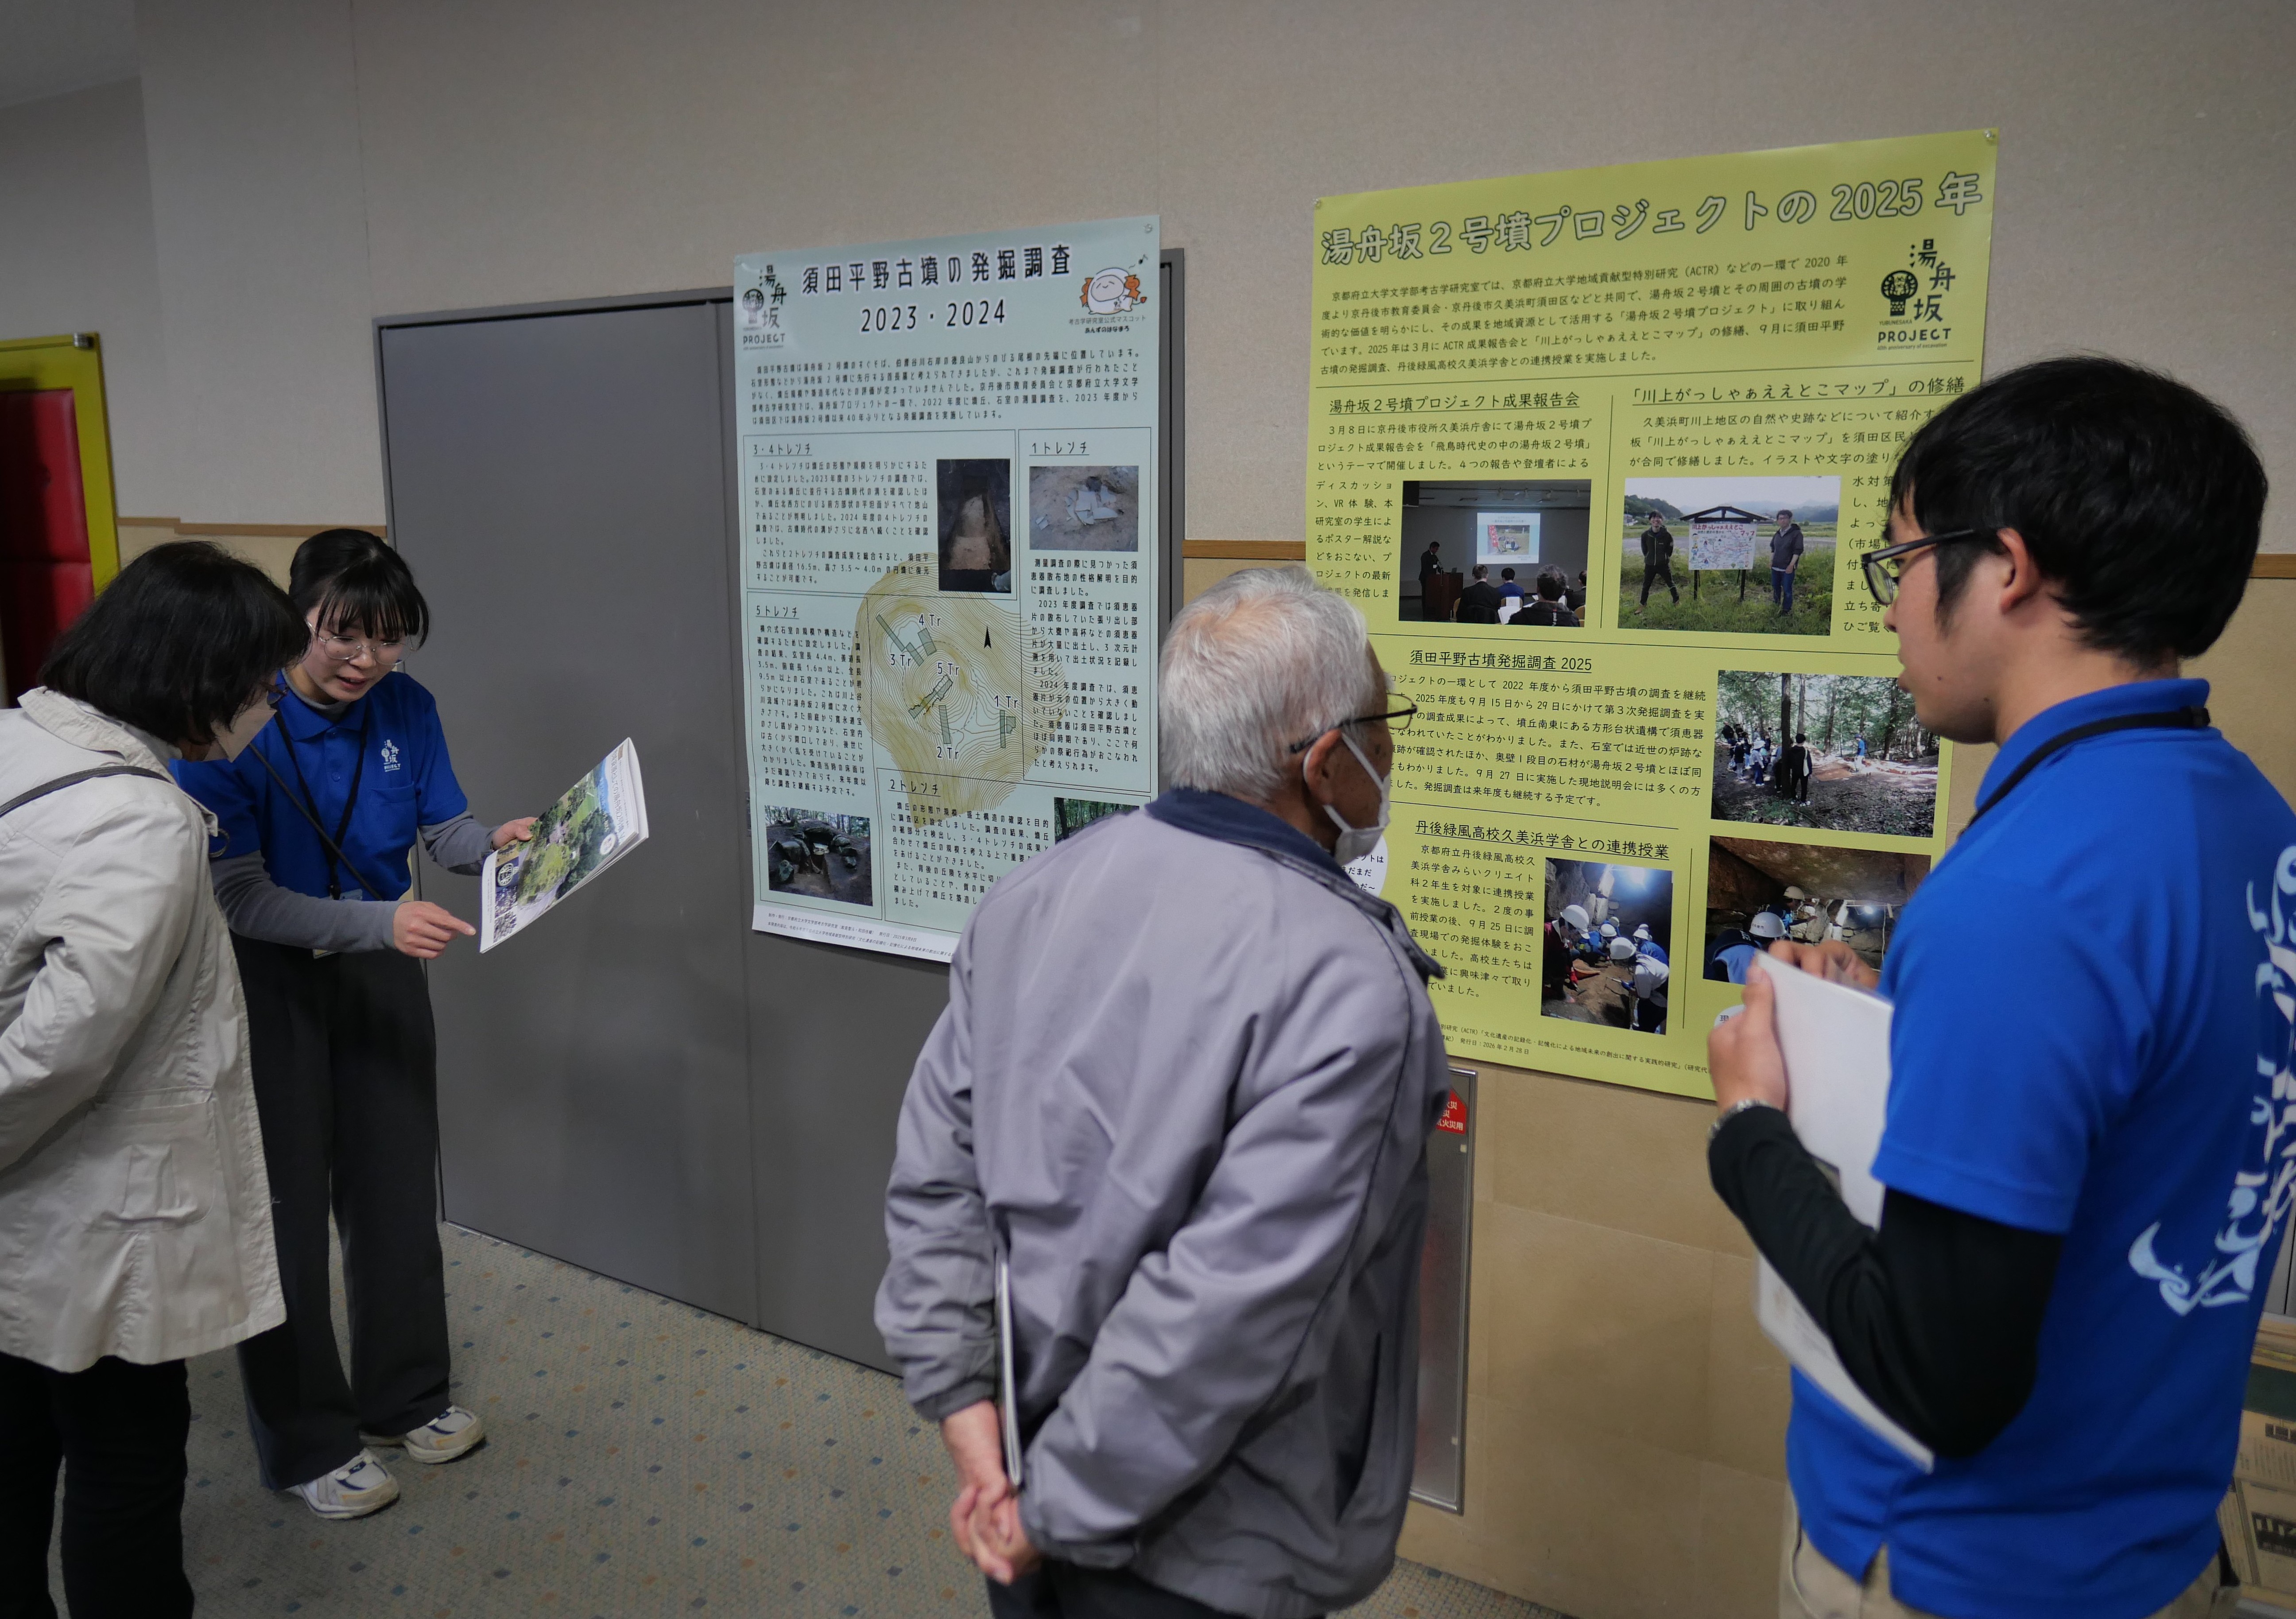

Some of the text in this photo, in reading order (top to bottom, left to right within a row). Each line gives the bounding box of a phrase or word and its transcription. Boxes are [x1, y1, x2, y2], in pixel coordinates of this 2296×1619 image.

[1831, 179, 1922, 221] 2025
[801, 244, 1072, 296] 須田平野古墳の発掘調査
[1069, 315, 1146, 325] 考古学研究室公式マスコット
[743, 334, 785, 345] PROJECT
[1878, 328, 1951, 343] PROJECT
[1032, 441, 1087, 454] 1トレンチ
[1316, 481, 1392, 490] ディスカッショ
[1315, 516, 1392, 526] 研究室の学生によ
[1317, 534, 1391, 544] るポスター解説な
[1035, 559, 1137, 569] 測量調査の際に見つかった須
[1317, 552, 1392, 562] どをおこない、プ
[756, 574, 816, 583] することが可能です。
[1031, 572, 1137, 584] 恵器散布地の性格解明を目的
[1316, 569, 1390, 580] ロジェクトの最新
[1031, 586, 1089, 596] に調査しました。
[756, 606, 797, 617] 5トレンチ
[1844, 601, 1888, 612] 立ち寄
[1032, 613, 1137, 625] 片の散布していた張り出し部
[760, 625, 859, 638] 横穴式石室の規模や構造などを
[757, 637, 860, 651] 確認するために設定しました。調
[1032, 653, 1136, 667] 測を用いて出土状況を記録し
[1410, 649, 1592, 671] 須田平野古墳発掘調査 2025
[1033, 667, 1058, 676] ました。
[760, 684, 861, 700] らかになりました。これは川上谷
[1033, 692, 1137, 708] 器片が元の位置から大きく動
[761, 709, 861, 725] きさです。また前庭から寛永通宝
[1033, 707, 1136, 722] いていないことを確認しまし
[761, 721, 862, 738] のさし銭がみつかるなど、石室内
[1033, 720, 1136, 735] た。須恵器は須田平野古墳と
[761, 732, 862, 749] は古くから開口しており、後世に
[1034, 733, 1137, 749] ほぼ同時期であり、ここで何
[761, 743, 863, 761] 大きくかく乱を受けていることが
[1035, 745, 1137, 762] らかの祭祀行為がおこなわれ
[763, 756, 864, 773] わかりました。築造当時の床面は
[1035, 759, 1098, 773] たと考えられます。
[765, 778, 854, 796] 降も調査を継続する予定です。
[891, 779, 938, 795] 2トレンチ
[891, 813, 1049, 841] に調査区を設定しました。調査の結果、墳丘
[1416, 820, 1669, 858] 丹後緑風高校久美浜学舎との連携授業
[892, 837, 1031, 862] 合わせて墳丘の規模を考える上で重要
[1421, 845, 1536, 866] 京都府立丹後緑風高校久
[894, 849, 984, 870] をあげることができました。
[1411, 860, 1534, 883] 美浜学舎みらいクリエイト
[894, 873, 989, 894] としていることや、質の異
[1411, 877, 1535, 901] 科2年生を対象に連携授業
[895, 897, 918, 908] ました。
[1410, 928, 1532, 952] 査現場での発掘体験をおこ
